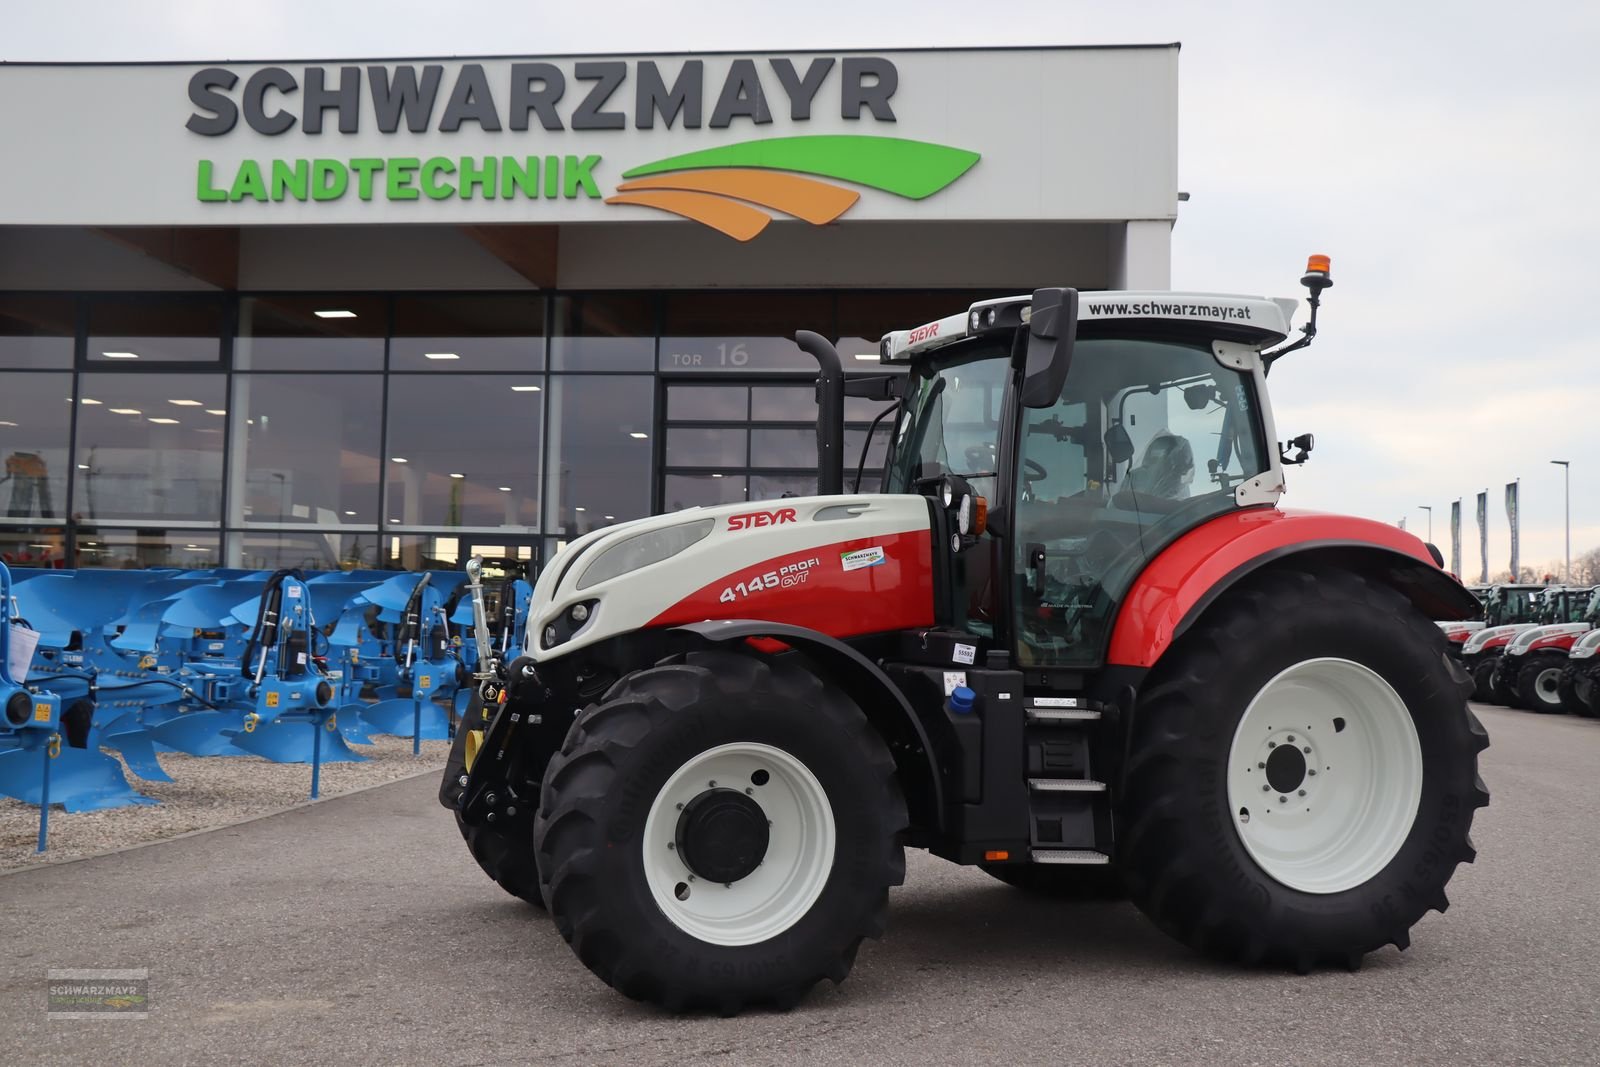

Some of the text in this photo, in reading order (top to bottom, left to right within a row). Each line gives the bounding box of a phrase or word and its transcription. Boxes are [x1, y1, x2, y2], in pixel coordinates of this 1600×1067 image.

[186, 57, 900, 136] SCHWARZMAYR
[198, 155, 604, 201] LANDTECHNIK
[1089, 301, 1251, 320] www.schwarzmayr.at
[909, 323, 939, 345] STEYR
[672, 343, 749, 366] TOR 16
[728, 508, 797, 531] STEYR
[719, 558, 820, 603] 4145 PROFI
[781, 570, 809, 588] CVT
